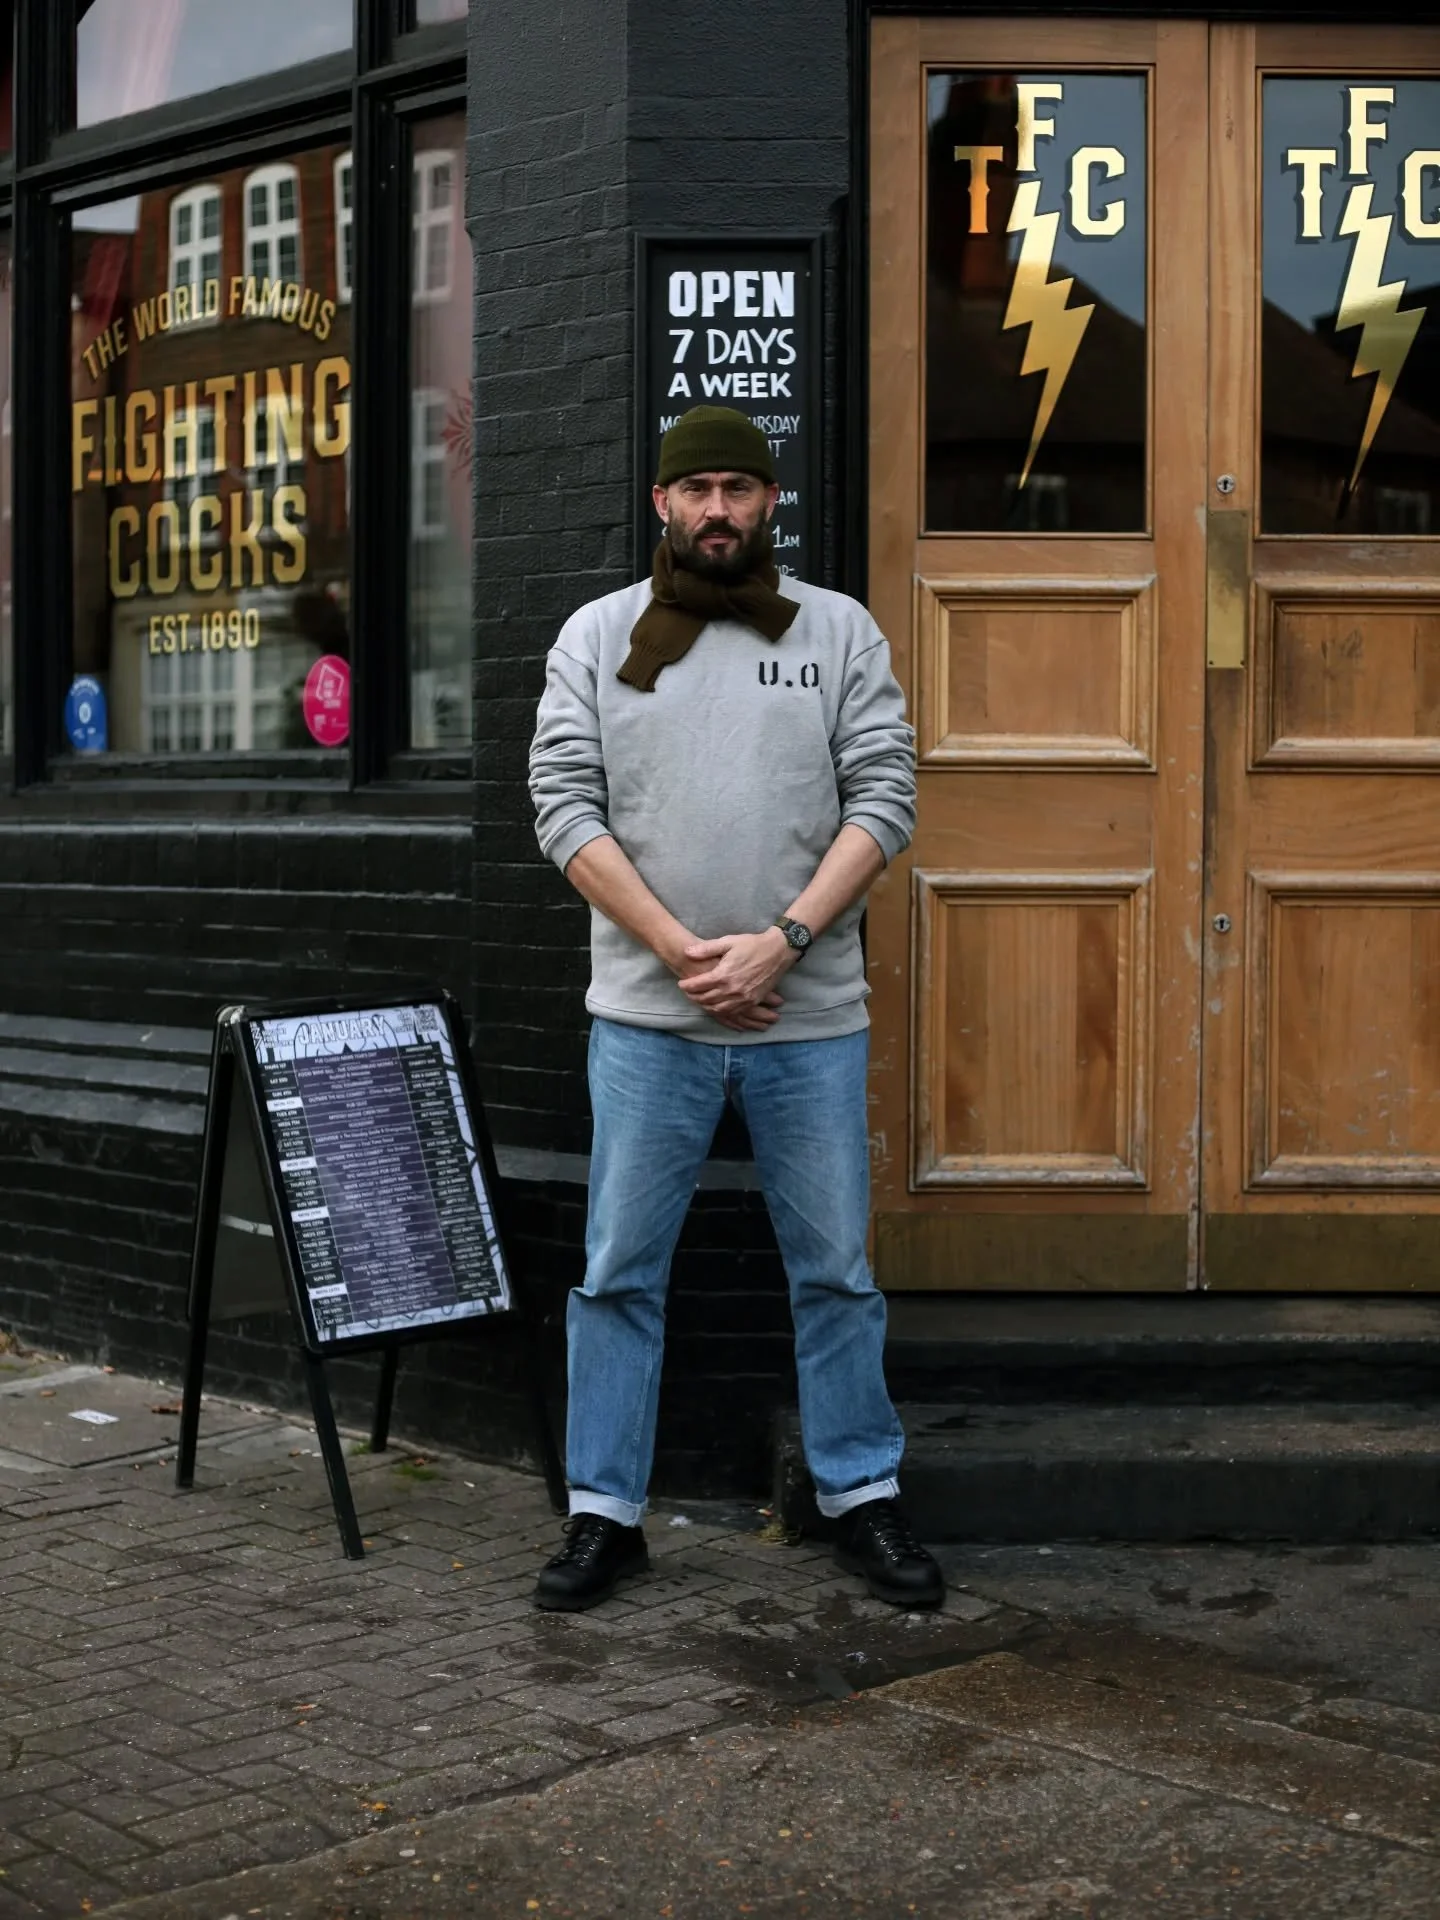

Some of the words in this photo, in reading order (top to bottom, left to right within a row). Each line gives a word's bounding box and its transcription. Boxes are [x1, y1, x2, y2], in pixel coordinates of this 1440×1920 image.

[669, 271, 795, 317] OPEN
[81, 317, 129, 381] THE
[132, 278, 220, 342] WORLD
[229, 276, 335, 341] FAMOUS
[669, 328, 695, 364] 7
[706, 327, 797, 365] DAYS
[667, 372, 692, 398] A
[700, 372, 792, 398] WEEK
[72, 356, 351, 492] FIGHTING
[109, 484, 307, 598] COCKS
[772, 524, 800, 548] 1AM
[150, 613, 195, 655] EST.
[202, 607, 260, 650] 1890
[298, 1015, 384, 1044] JANUARY
